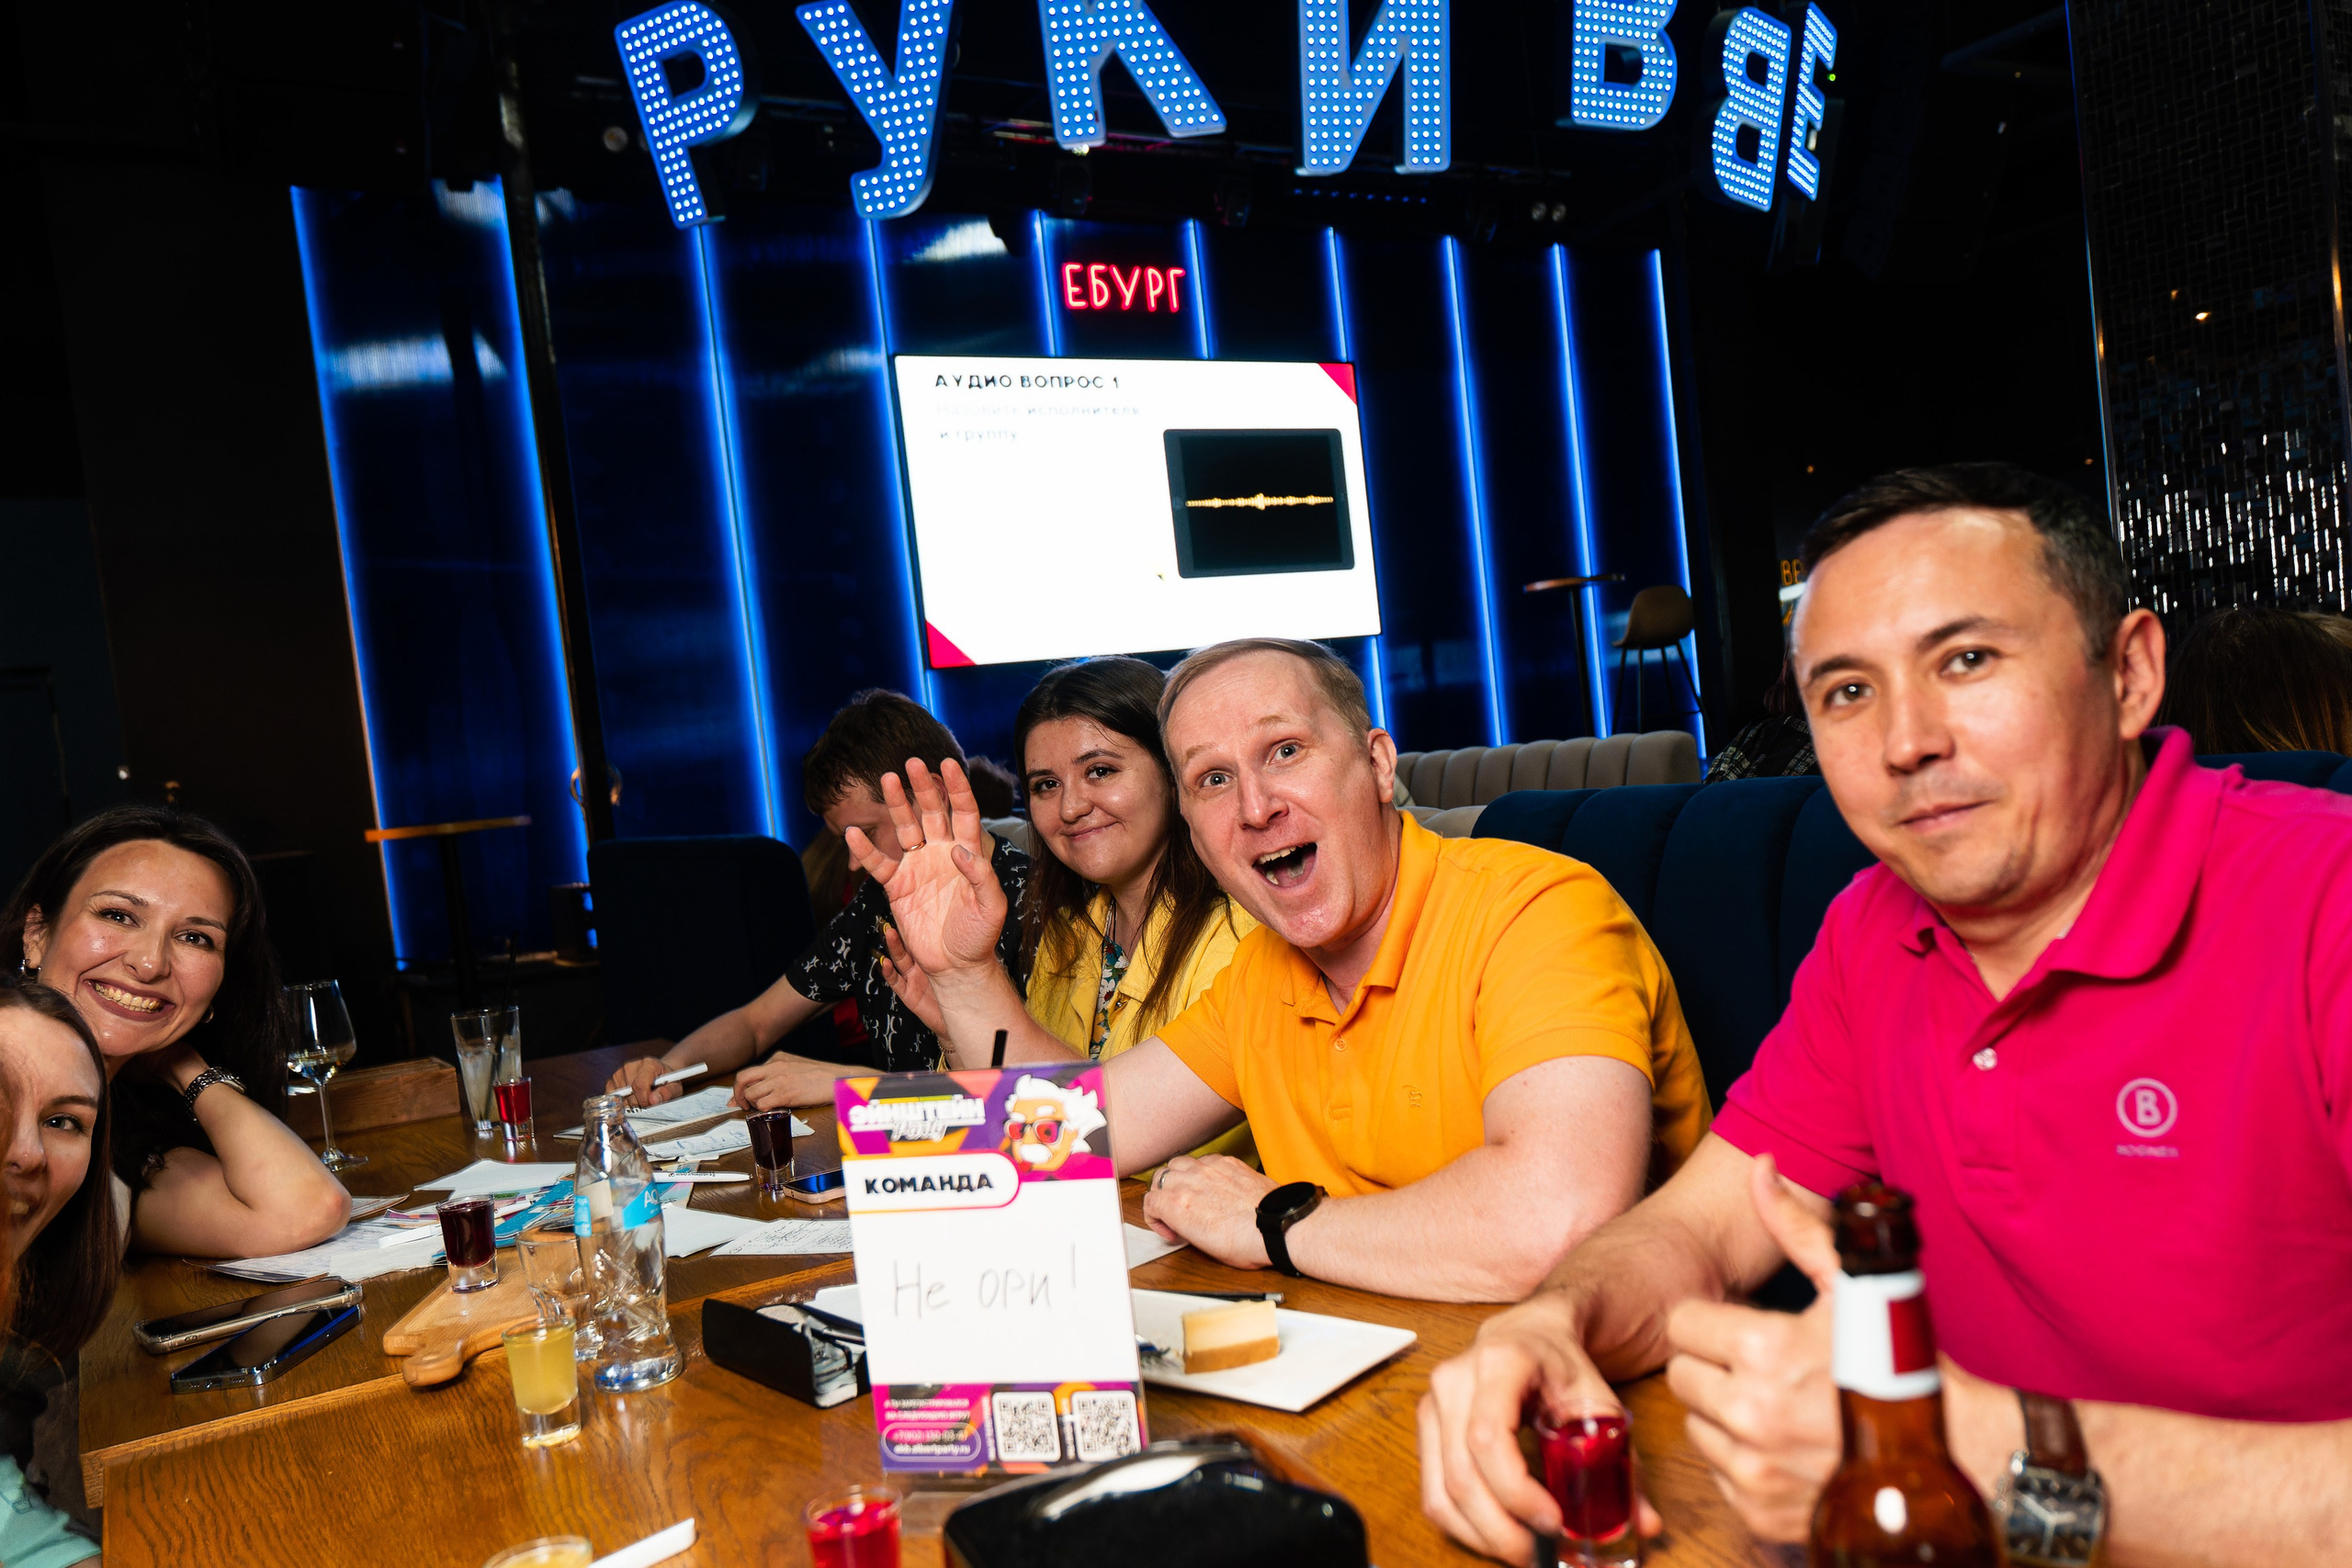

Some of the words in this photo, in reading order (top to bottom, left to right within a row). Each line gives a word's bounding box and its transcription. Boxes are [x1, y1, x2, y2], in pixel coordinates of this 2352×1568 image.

[614, 0, 1452, 230] РУКИ
[1062, 263, 1186, 312] ЕБУРГ
[935, 374, 1012, 389] АУДИО
[1020, 375, 1104, 389] ВОПРОС
[1113, 376, 1120, 389] 1
[1027, 404, 1140, 415] исполнителя
[940, 431, 949, 440] и
[956, 430, 1018, 443] группу
[849, 1094, 986, 1125] ЭЙНШТЕЙН
[2134, 1088, 2163, 1127] B
[865, 1174, 994, 1194] КОМАНДА
[893, 1259, 951, 1319] Не
